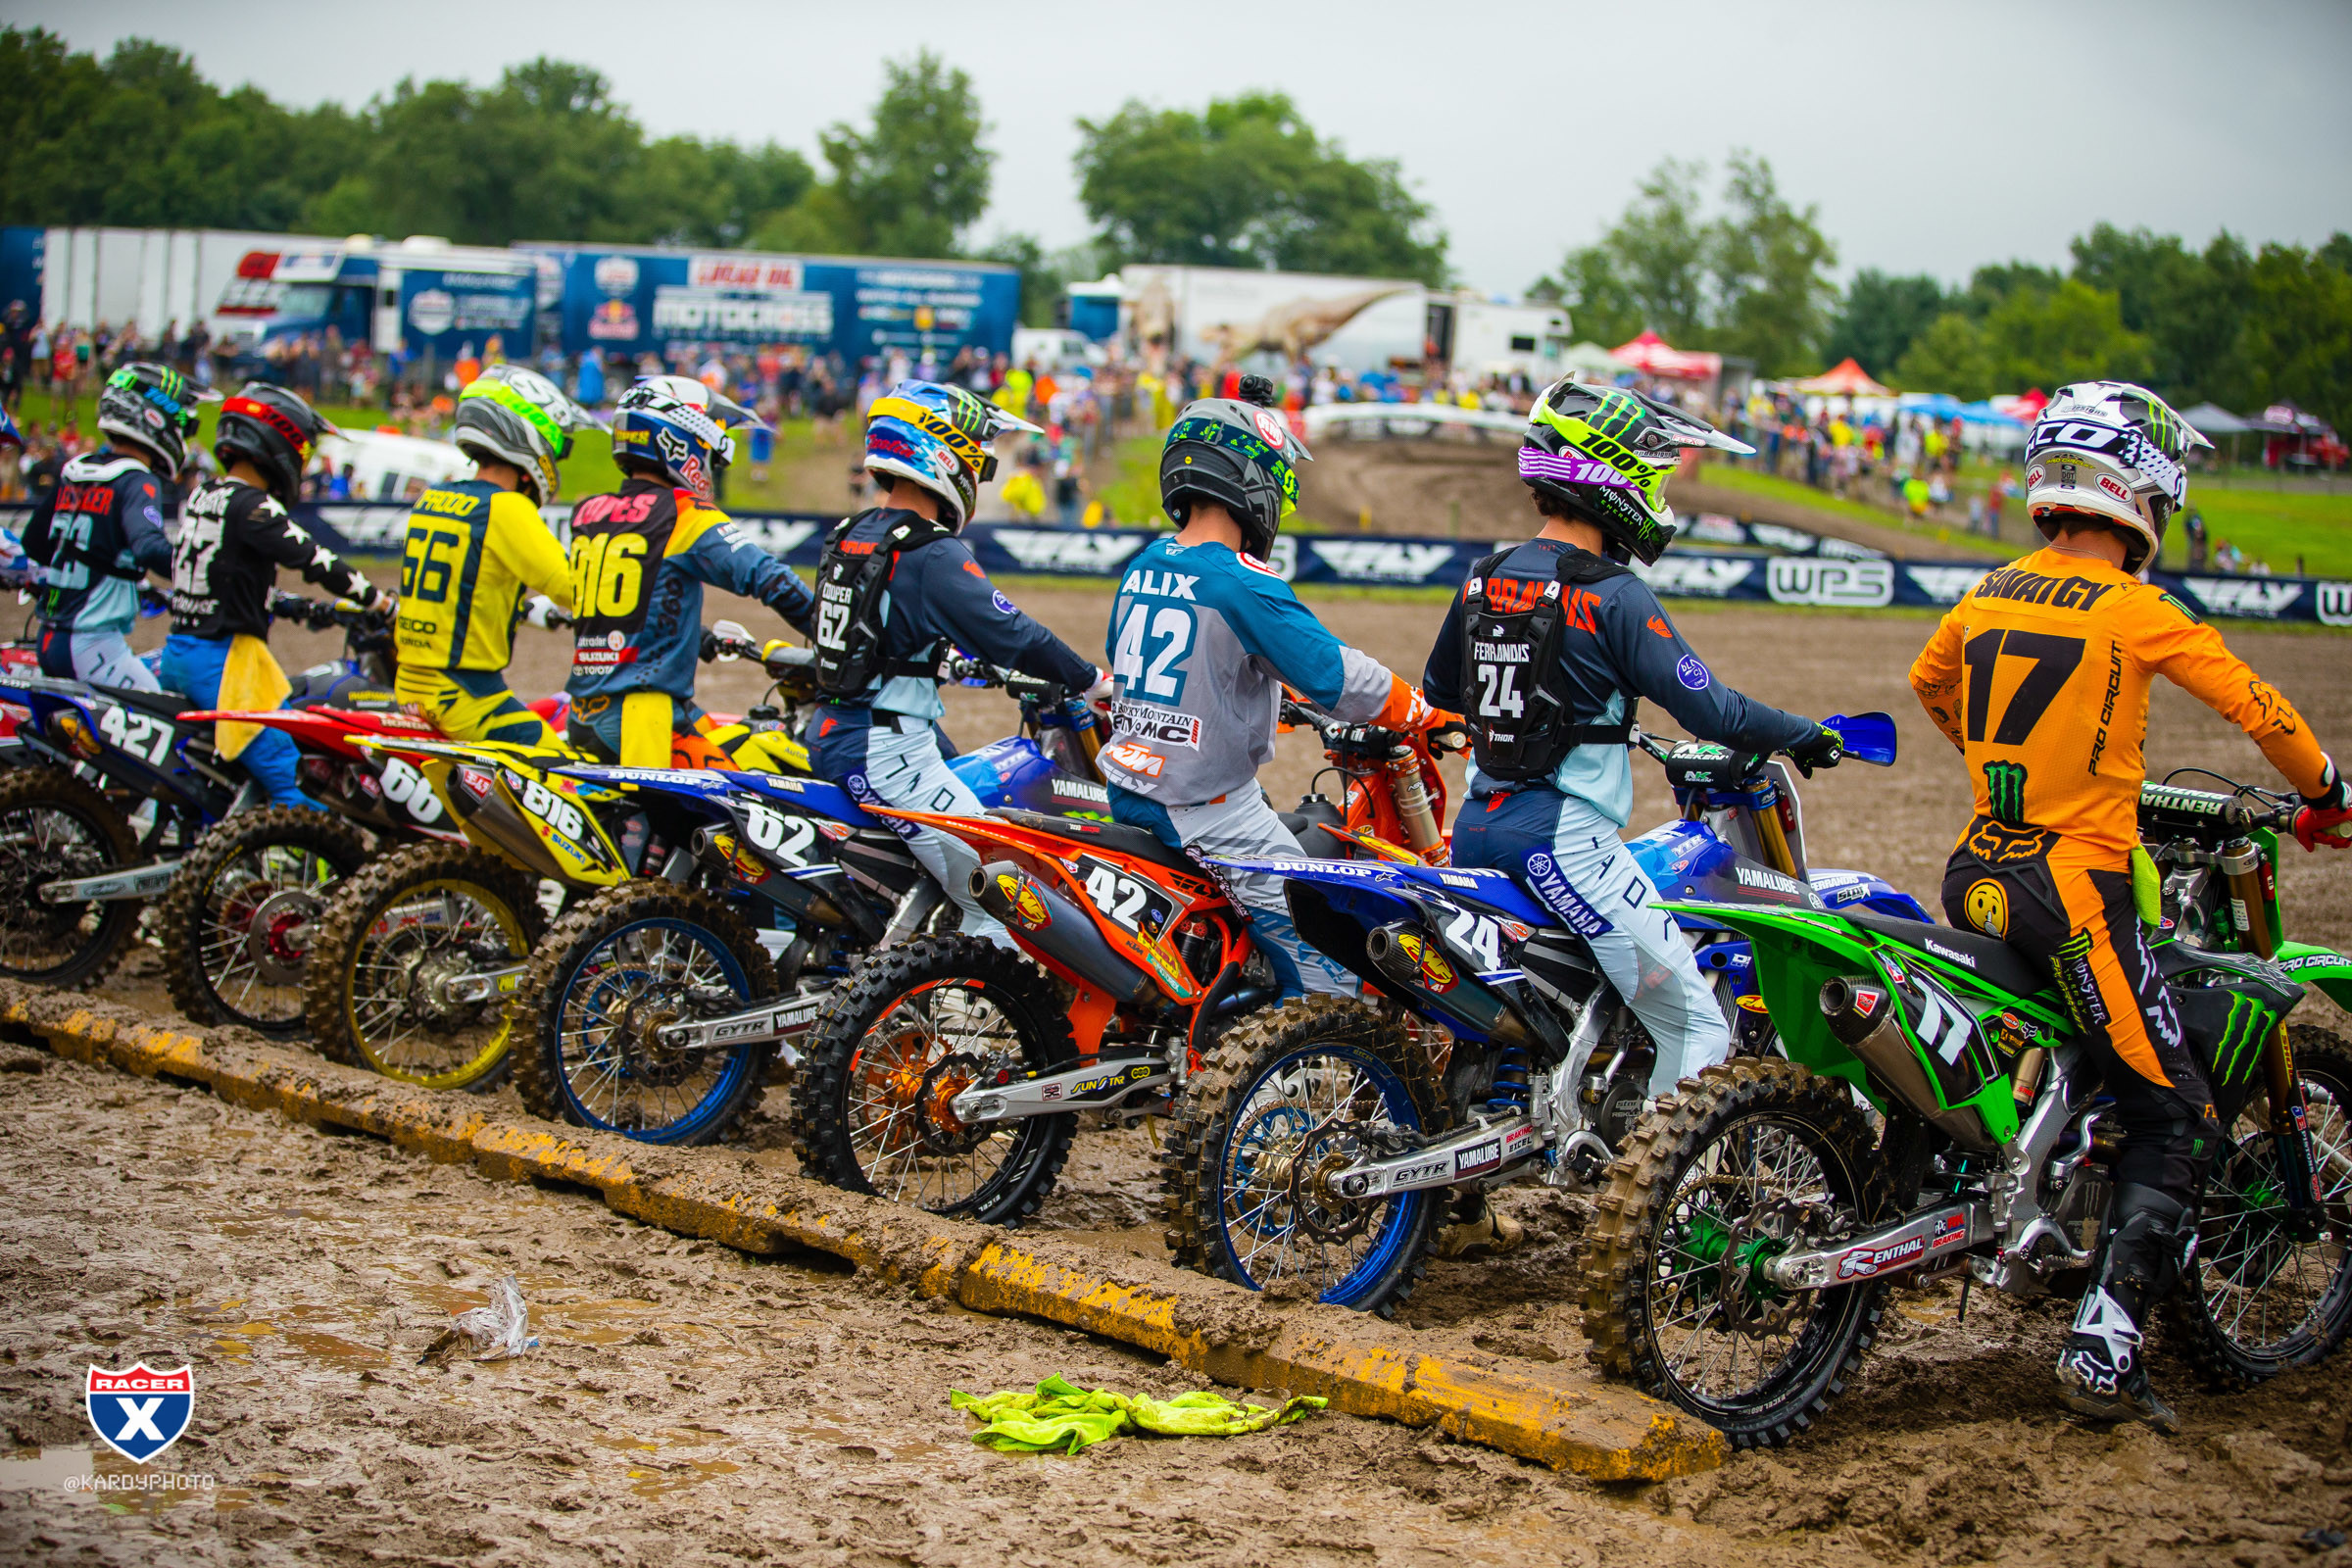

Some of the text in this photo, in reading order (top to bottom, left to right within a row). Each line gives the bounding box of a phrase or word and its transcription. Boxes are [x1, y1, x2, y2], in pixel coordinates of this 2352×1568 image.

[919, 411, 982, 468] 100%
[937, 450, 956, 472] BELL
[1580, 432, 1657, 488] 100%
[2028, 469, 2042, 488] BELL
[2099, 476, 2128, 501] BELL
[1599, 485, 1643, 526] MONSTER
[1600, 500, 1635, 526] ENERGY
[821, 582, 854, 605] COOPER
[1121, 569, 1200, 601] ALIX
[1767, 555, 1895, 608] WPS
[1975, 567, 2115, 612] SAVATGY
[2183, 576, 2303, 613] FLY
[817, 600, 851, 652] 62
[578, 651, 619, 662] SUZUKI
[1113, 603, 1192, 698] 42
[1473, 642, 1530, 663] FERRANDIS
[1477, 664, 1525, 718] 24
[1964, 628, 2086, 746] 17
[2087, 640, 2126, 776] PRO CIRCUIT
[100, 705, 175, 766] 427
[1494, 733, 1515, 744] THOR
[1107, 743, 1165, 778] KTM
[379, 757, 444, 823] 66
[608, 769, 703, 786] DUNLOP
[765, 776, 805, 794] YAMAHA
[1102, 760, 1157, 795] FLY
[522, 779, 584, 841] 816
[2141, 794, 2224, 815] RENTHA
[551, 833, 586, 864] SUZUKI
[747, 802, 815, 867] 62
[1273, 861, 1372, 877] DUNLOP
[1438, 872, 1479, 890] YAMAHA
[1735, 866, 1799, 895] YAMALUBE
[1085, 865, 1147, 932] 42
[1168, 871, 1224, 900] FLY
[1539, 871, 1603, 935] YAMAHA
[1125, 940, 1145, 956] KTM
[1444, 900, 1501, 971] 24
[1925, 938, 1976, 969] Kawasaki
[2278, 956, 2304, 973] PRO
[714, 1019, 768, 1038] GYTR
[1505, 1126, 1534, 1144] BRAKING
[1508, 1137, 1533, 1153] EXCEL
[1395, 1160, 1447, 1182] GYTR
[1457, 1144, 1500, 1170] YAMALUBE
[1932, 1229, 1966, 1249] BRAKING
[1839, 1237, 1925, 1277] RENTHAL
